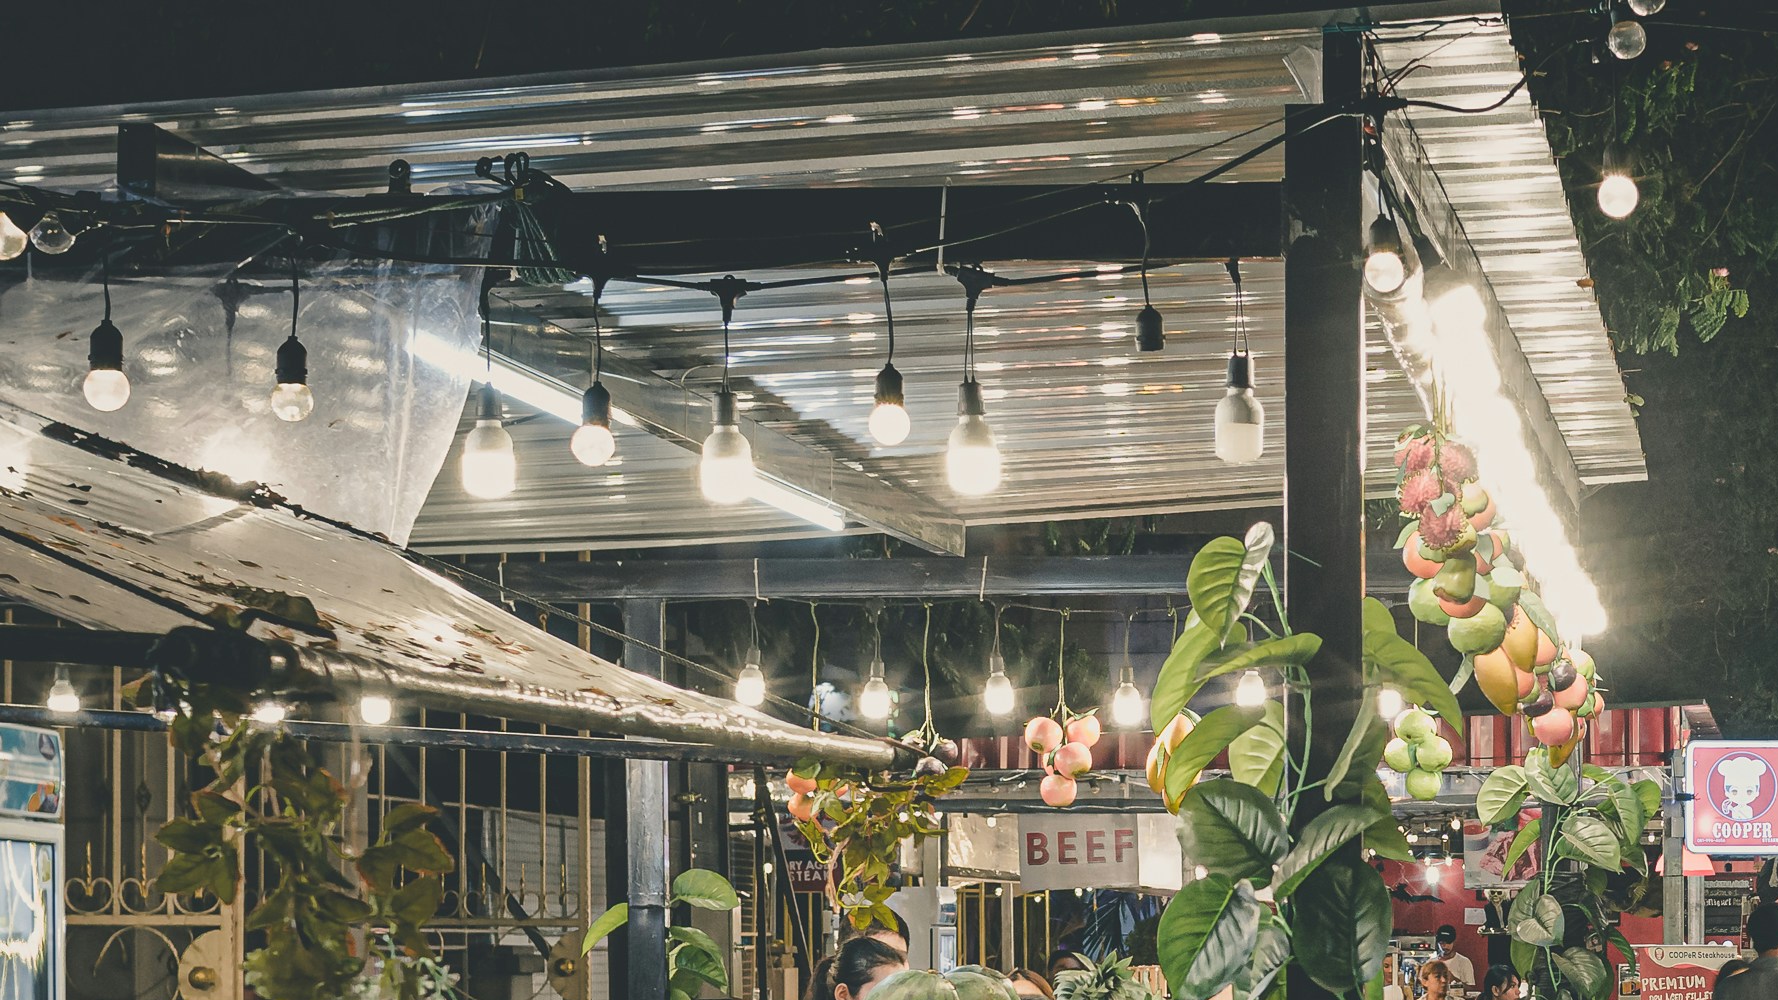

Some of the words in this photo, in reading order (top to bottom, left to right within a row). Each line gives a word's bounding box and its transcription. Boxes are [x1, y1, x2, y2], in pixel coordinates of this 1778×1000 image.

[1712, 822, 1773, 839] COOPER
[1026, 829, 1135, 865] BEEF
[788, 860, 804, 871] RY
[1697, 950, 1736, 959] Steakhouse
[1641, 974, 1706, 992] PREMIUM
[1685, 991, 1714, 1000] FILLET
